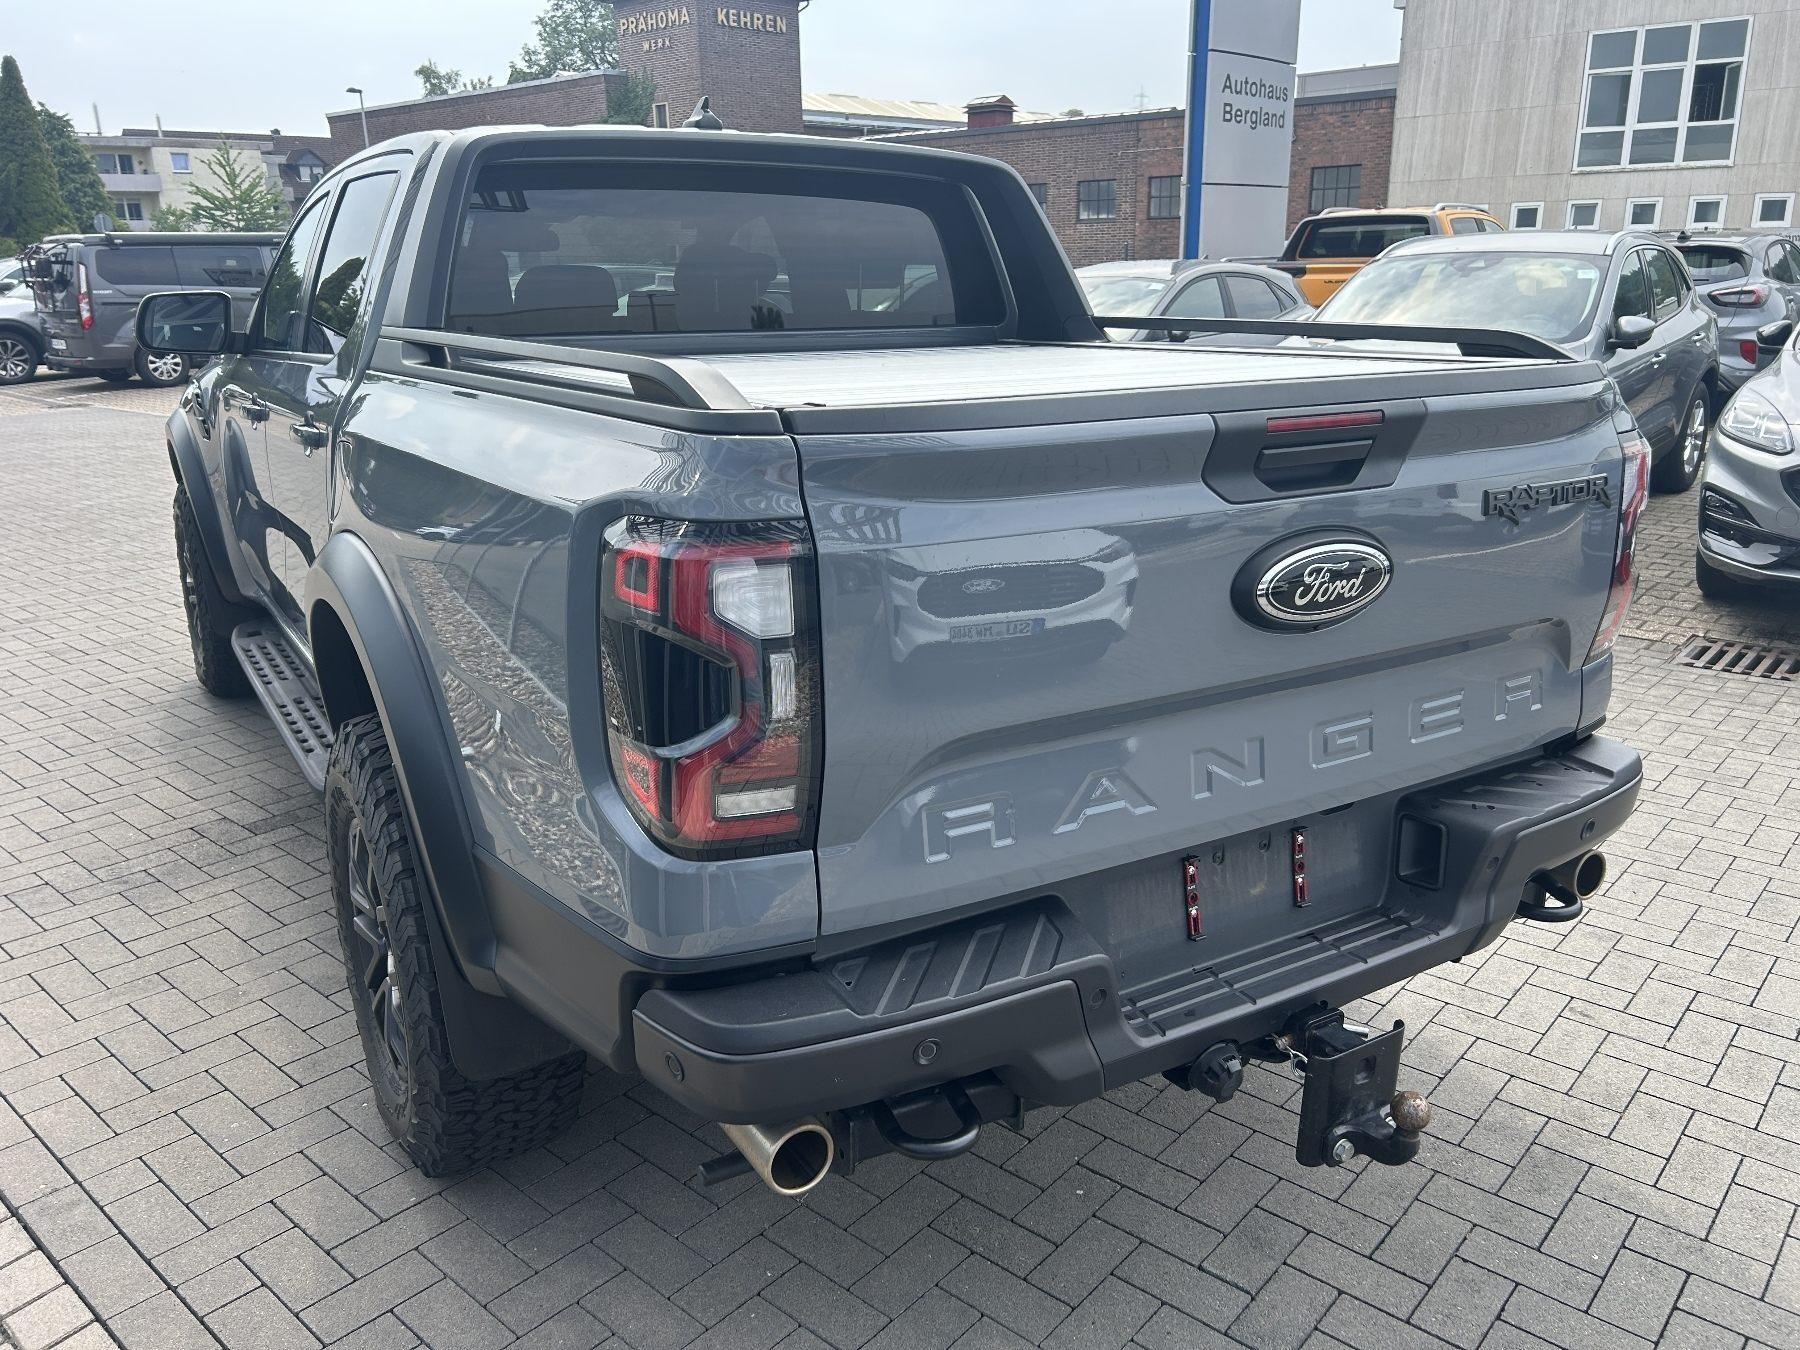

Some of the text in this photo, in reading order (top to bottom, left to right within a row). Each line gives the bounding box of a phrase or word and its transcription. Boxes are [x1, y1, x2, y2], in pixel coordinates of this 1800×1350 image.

[620, 7, 690, 35] PRÄHOMA
[717, 7, 787, 33] KEHREN
[642, 37, 671, 51] WERK
[1222, 73, 1288, 102] Autohaus
[1222, 102, 1286, 130] Bergland
[1481, 473, 1611, 525] RAPTOR
[1294, 561, 1367, 606] Ford
[922, 668, 1543, 864] RANGER
